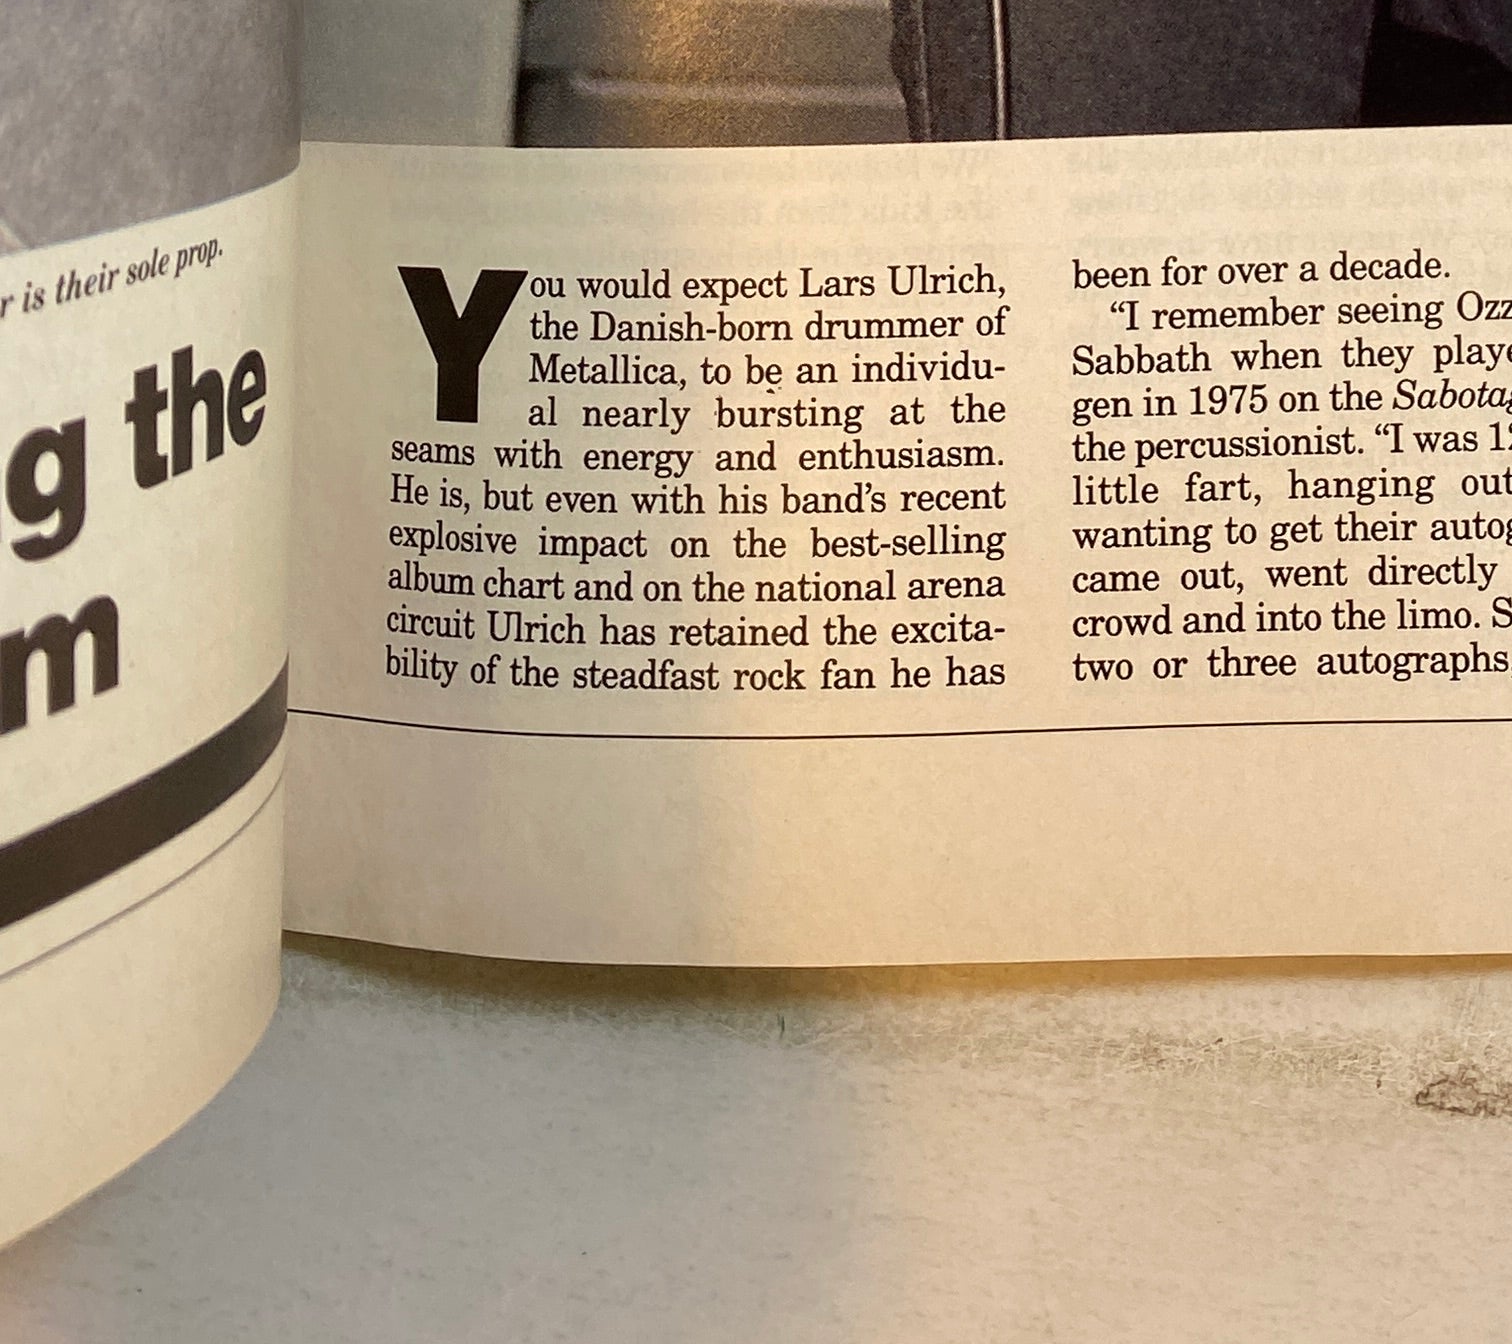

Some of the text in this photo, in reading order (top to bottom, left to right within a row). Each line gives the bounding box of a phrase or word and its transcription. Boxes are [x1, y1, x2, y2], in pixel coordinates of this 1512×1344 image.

[22, 281, 46, 314] is
[55, 261, 121, 305] their
[126, 247, 171, 286] sole
[174, 237, 224, 279] prop.
[575, 268, 672, 300] would
[682, 270, 788, 307] expect
[798, 267, 876, 298] Lars
[886, 262, 1006, 300] Ulrich,
[1071, 247, 1451, 290] been for over a decade.
[529, 304, 1012, 343] the Danish-born drummer of
[528, 348, 1006, 392] Metallica, to be an individu-
[1072, 341, 1213, 377] Sabbath
[1230, 338, 1323, 371] when
[1340, 336, 1415, 375] they
[125, 344, 268, 490] the
[1071, 396, 1134, 427] gen
[1142, 386, 1178, 417] in
[1189, 383, 1269, 416] 1975
[1278, 391, 1321, 414] on
[1328, 379, 1383, 412] the
[391, 437, 1004, 479] seams with energy and enthusiasm.
[1071, 430, 1126, 463] the
[1134, 424, 1364, 469] percussionist.
[1374, 422, 1405, 454] “I
[1412, 430, 1479, 454] was
[389, 472, 1007, 516] He is, but even with his band’s recent
[1072, 472, 1159, 506] little
[1184, 470, 1262, 508] fart,
[1287, 467, 1436, 507] hanging
[1071, 516, 1214, 554] wanting
[1223, 516, 1258, 545] to
[1269, 513, 1324, 552] get
[1333, 510, 1418, 543] their
[387, 559, 1007, 603] album chart and on the national arena
[1072, 602, 1174, 638] crowd
[1182, 601, 1247, 635] and
[1255, 601, 1322, 633] into
[1330, 598, 1387, 631] the
[1395, 597, 1481, 630] limo.
[385, 643, 1006, 692] bility of the steadfast rock fan he has
[1071, 652, 1134, 682] two
[1152, 656, 1189, 680] or
[1206, 645, 1297, 678] three
